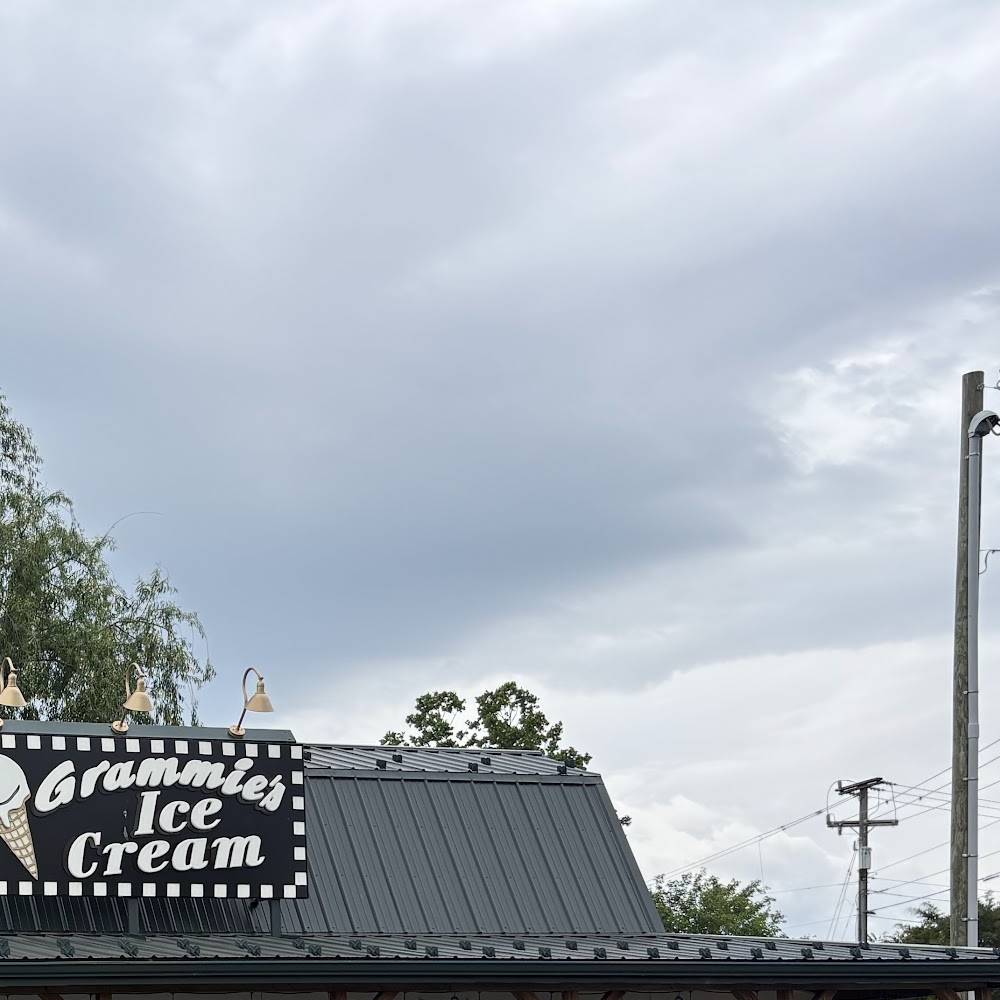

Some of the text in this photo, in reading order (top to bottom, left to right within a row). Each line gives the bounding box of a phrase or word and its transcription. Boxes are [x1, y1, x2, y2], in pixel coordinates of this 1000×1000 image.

[34, 757, 287, 813] Grammie's
[134, 790, 222, 836] Ice
[67, 831, 265, 878] Cream
